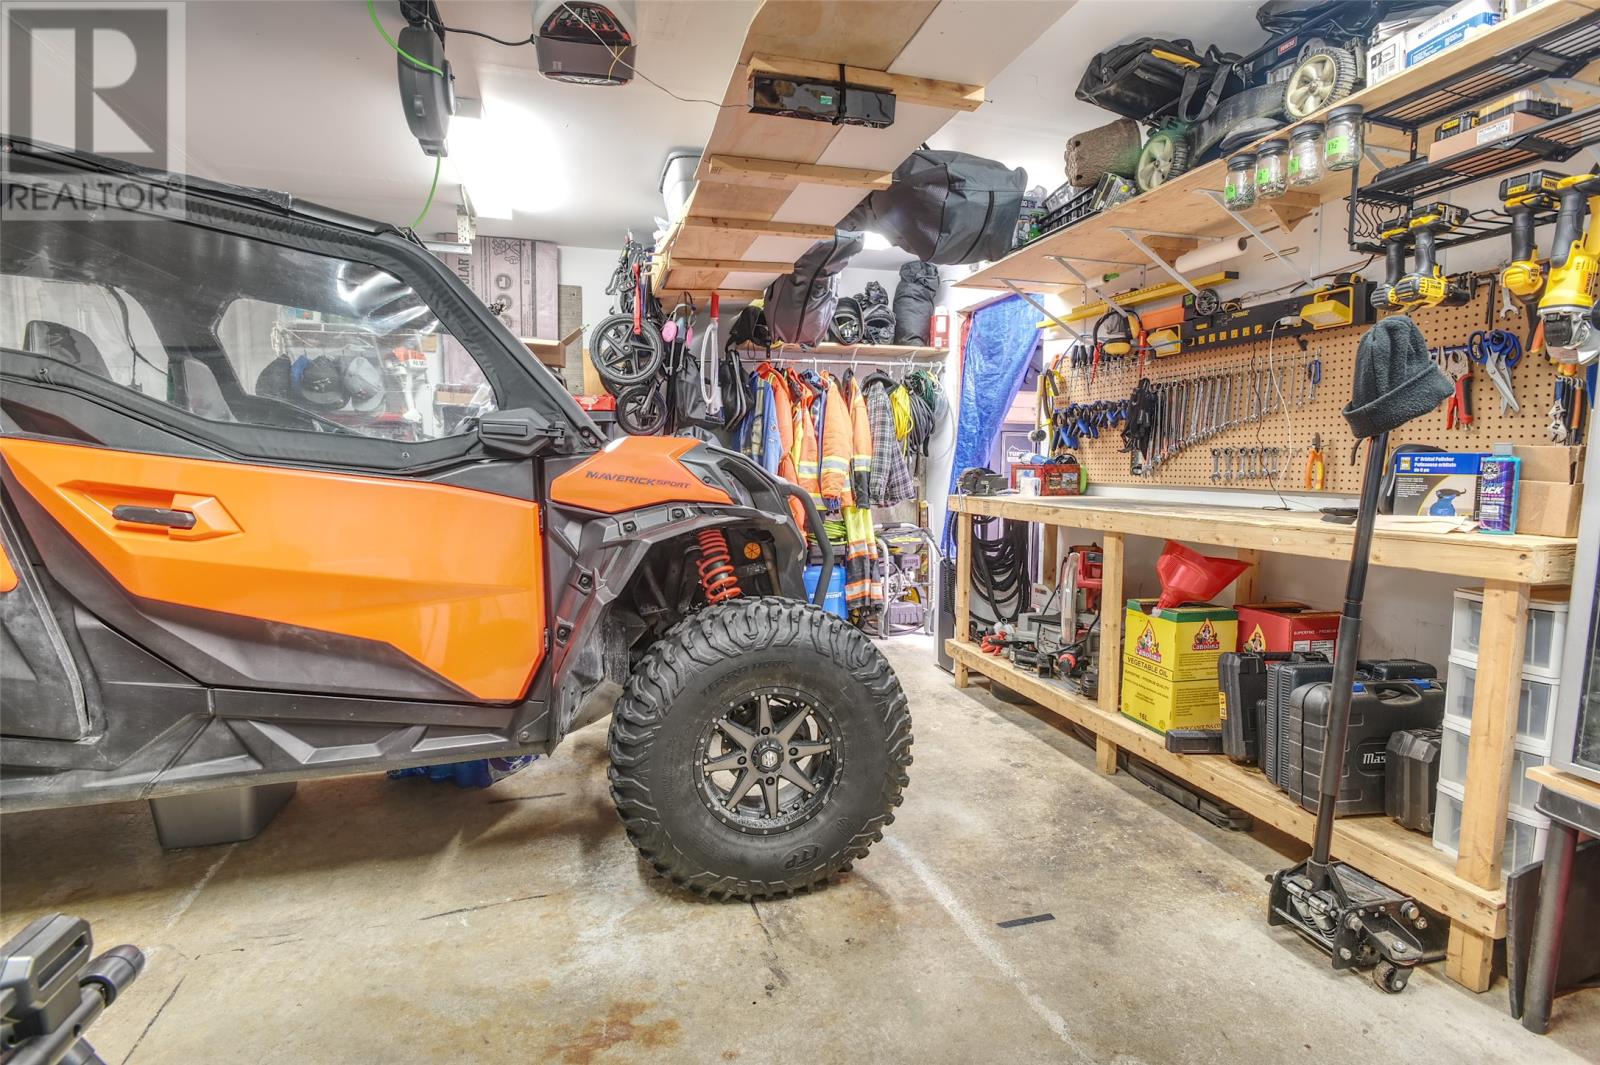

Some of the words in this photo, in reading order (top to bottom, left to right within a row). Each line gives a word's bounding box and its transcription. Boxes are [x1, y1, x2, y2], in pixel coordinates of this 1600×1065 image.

[585, 470, 656, 486] MAVERICK
[656, 479, 691, 489] SPORT
[1127, 656, 1158, 674] VEGETABLE
[1158, 668, 1168, 678] OIL
[1362, 751, 1386, 765] Mas
